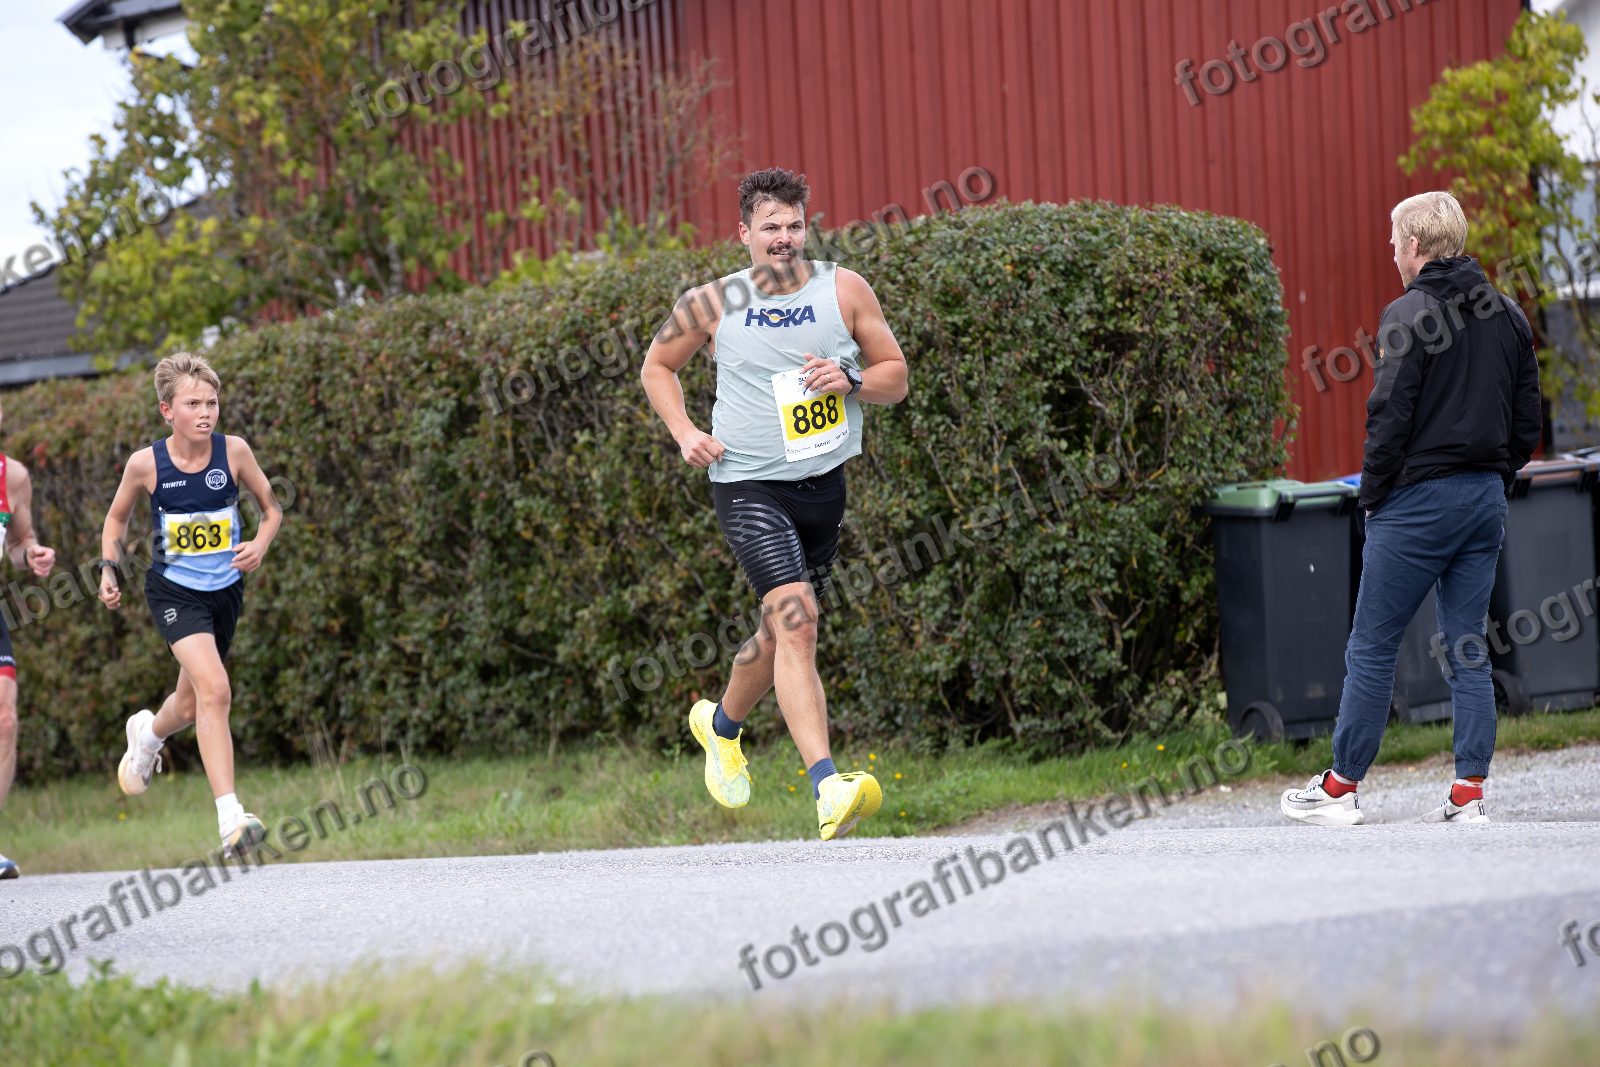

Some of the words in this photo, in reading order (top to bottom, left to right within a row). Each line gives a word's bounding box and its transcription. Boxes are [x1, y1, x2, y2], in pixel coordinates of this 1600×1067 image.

[745, 305, 816, 327] HOKA
[792, 394, 839, 434] 888
[162, 480, 187, 489] TRIMTEX
[176, 523, 222, 549] 863
